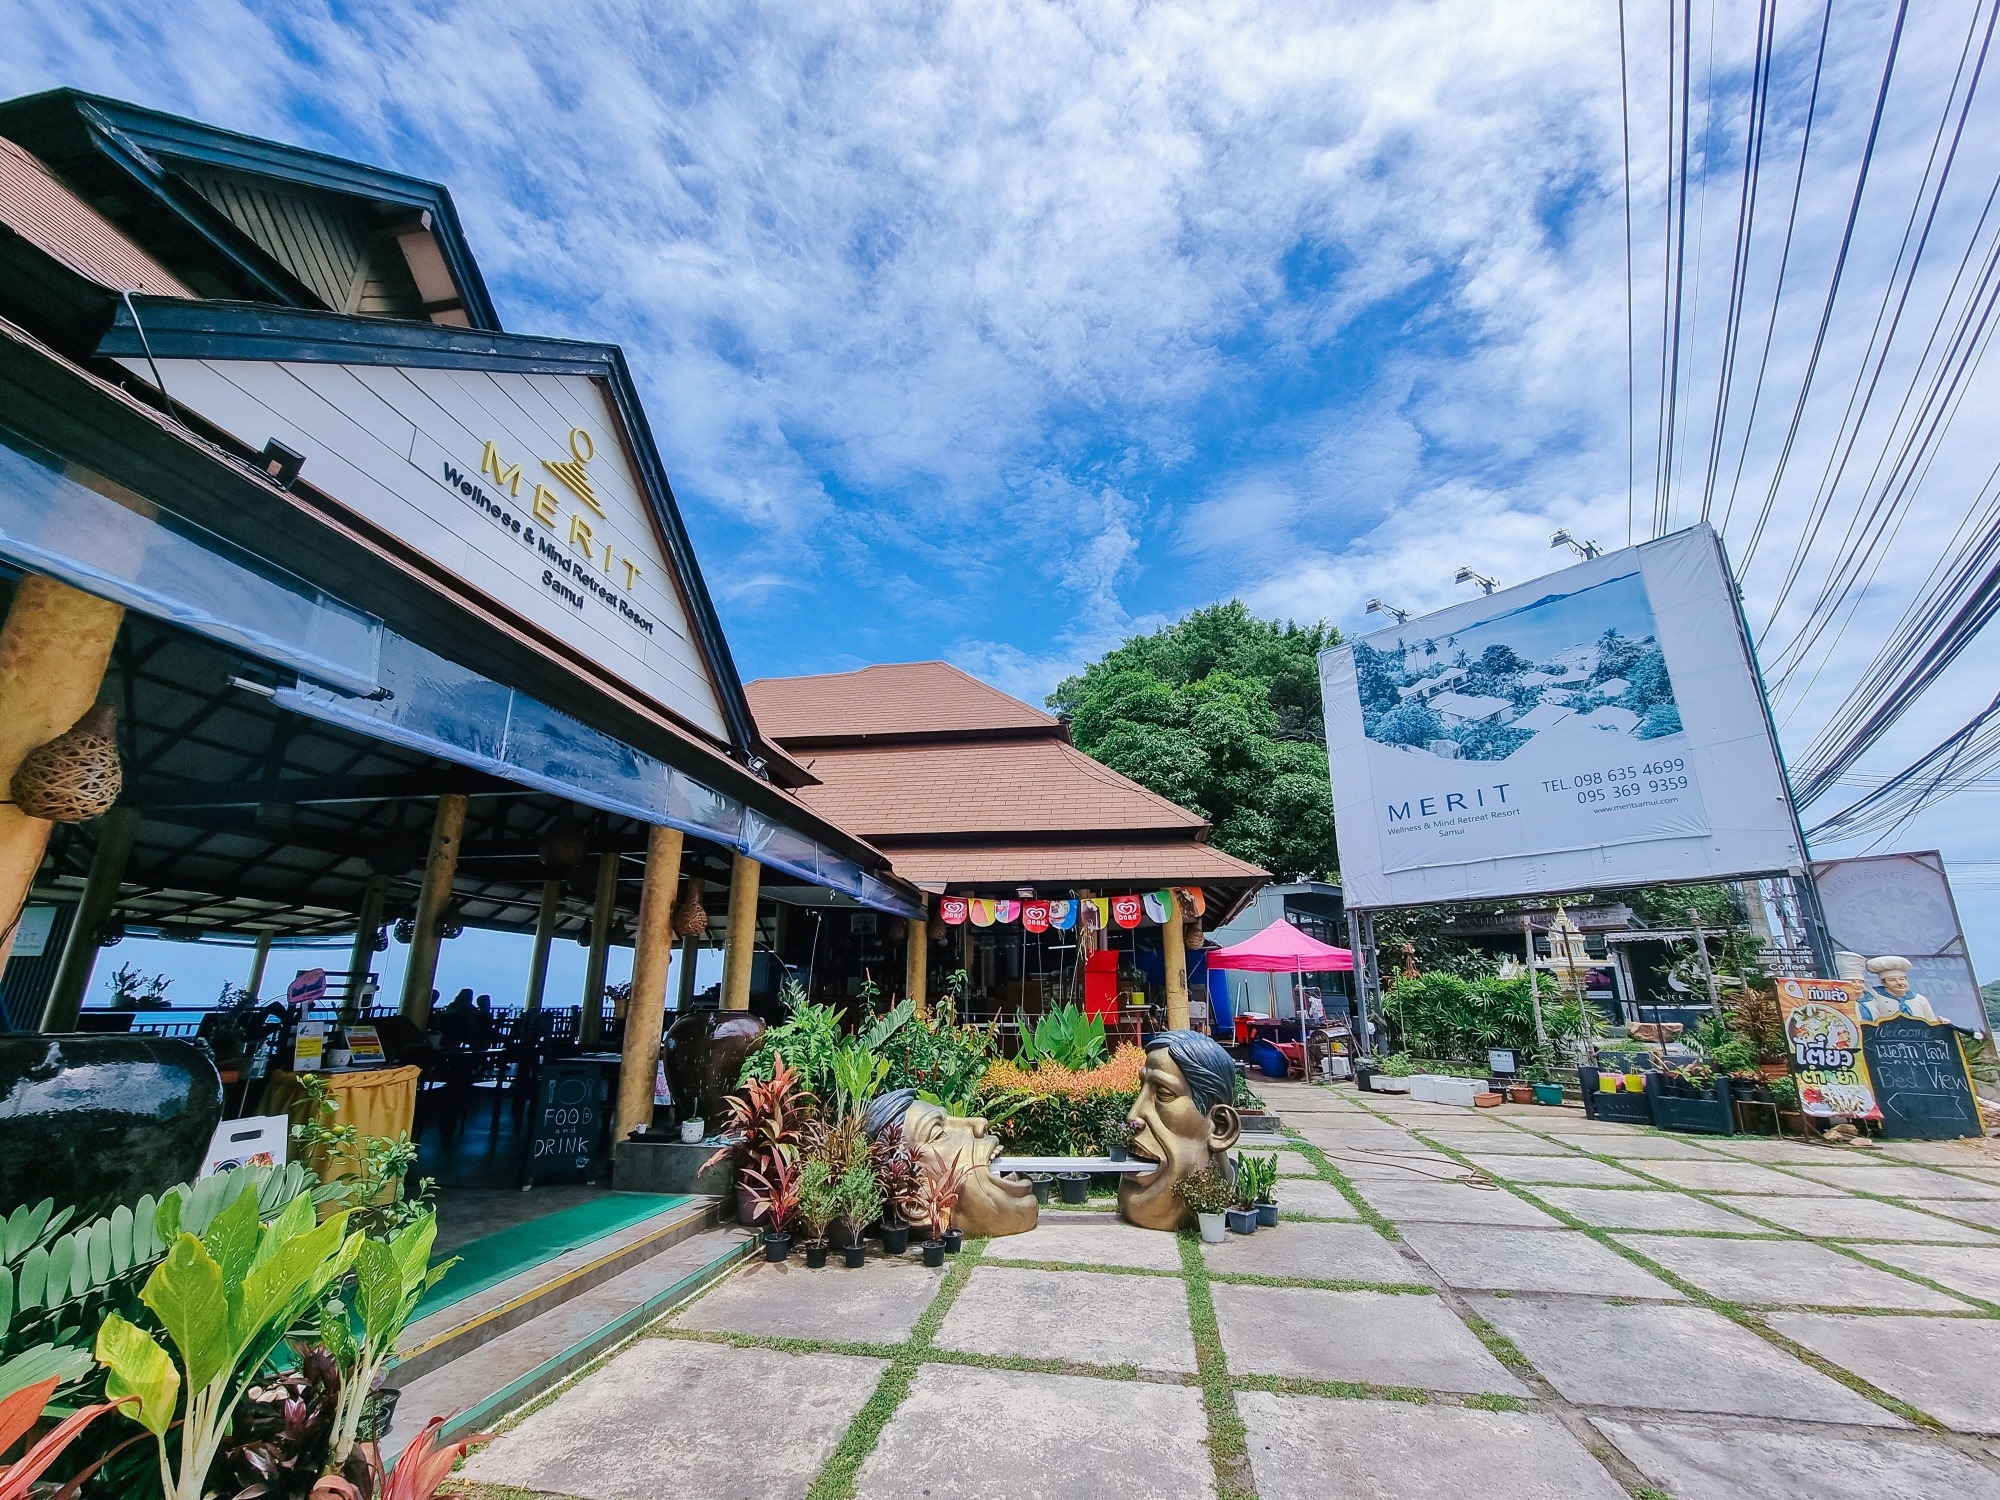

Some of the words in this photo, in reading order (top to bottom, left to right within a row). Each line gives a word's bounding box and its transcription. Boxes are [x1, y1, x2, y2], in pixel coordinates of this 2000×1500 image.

[482, 439, 642, 590] MERIT
[444, 462, 521, 534] Wellness
[523, 527, 535, 545] &
[539, 536, 571, 572] Mind
[573, 562, 618, 608] Retreat
[619, 600, 654, 635] Resort
[542, 570, 584, 610] Samui
[1542, 779, 1572, 793] TEL.
[1574, 772, 1602, 788] 098
[1607, 766, 1637, 782] 635
[1642, 758, 1685, 776] 4699
[1577, 788, 1606, 804] 095
[1613, 782, 1641, 799] 369
[1649, 775, 1689, 794] 9359
[1388, 784, 1510, 822] MERIT
[1593, 797, 1679, 814] www.meritsamui.com
[1387, 822, 1422, 836] Wellness
[1424, 821, 1432, 829] &
[1433, 817, 1455, 828] Mind
[1457, 812, 1489, 825] Retreat
[1490, 807, 1521, 819] Resort
[1438, 827, 1466, 838] Samui
[1769, 963, 1806, 971] Coffee
[1875, 1025, 1933, 1039] Welcome
[1877, 1066, 1921, 1090] Best
[1924, 1066, 1969, 1092] View
[544, 1107, 593, 1126] FOOD
[555, 1126, 576, 1134] and
[534, 1137, 590, 1158] DRINK
